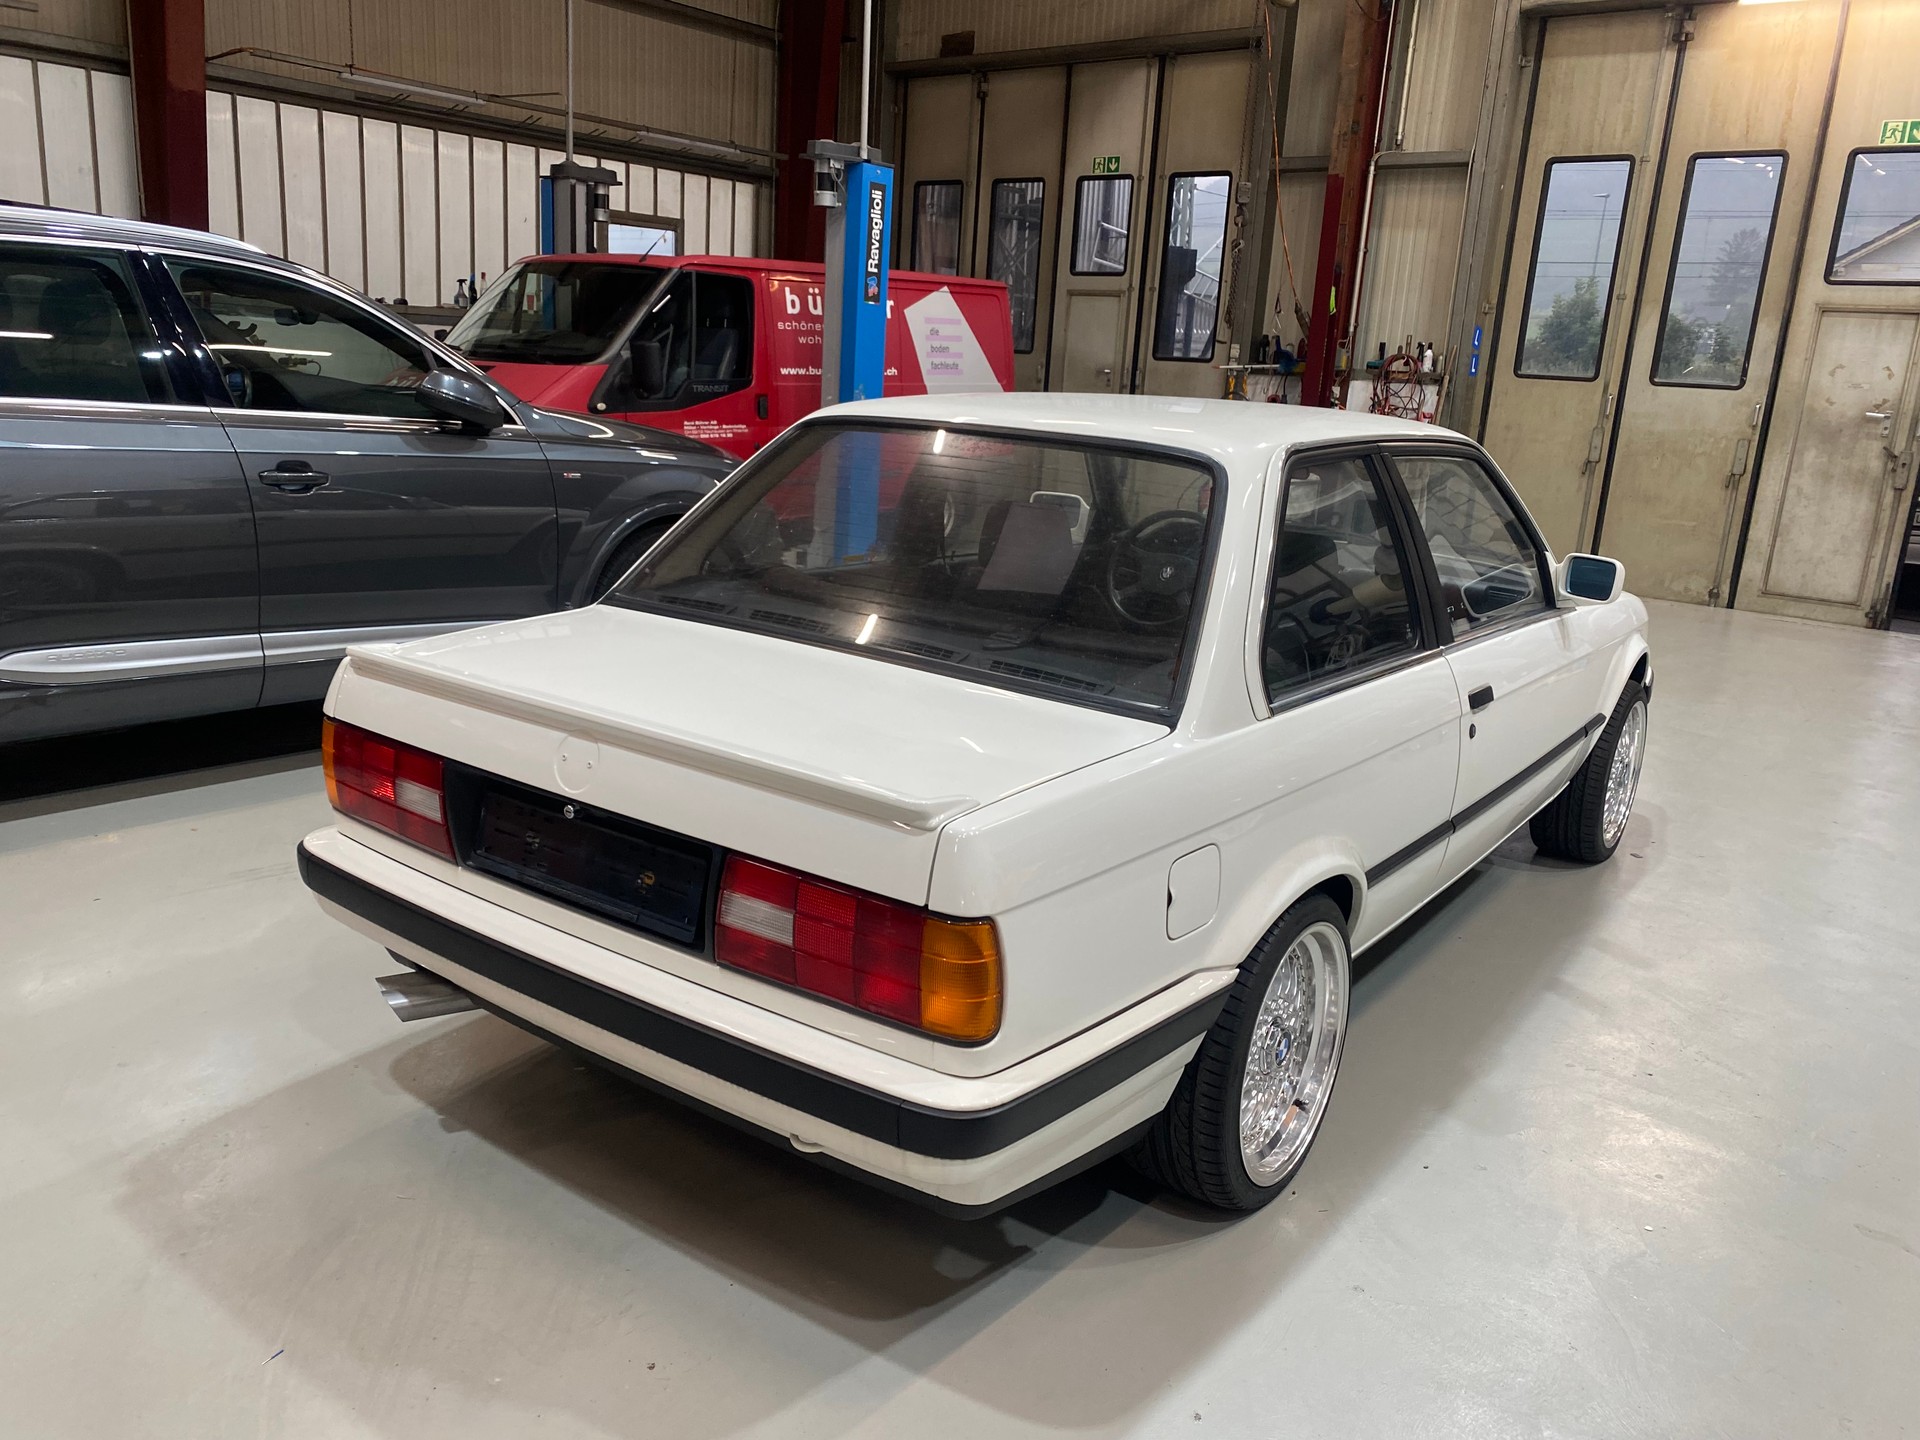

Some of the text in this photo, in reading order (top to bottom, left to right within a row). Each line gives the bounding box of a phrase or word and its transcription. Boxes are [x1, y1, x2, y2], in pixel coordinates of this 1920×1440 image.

[867, 189, 883, 273] Ravaglioli
[929, 327, 940, 336] die
[930, 344, 950, 353] boden
[930, 361, 959, 370] fachleute
